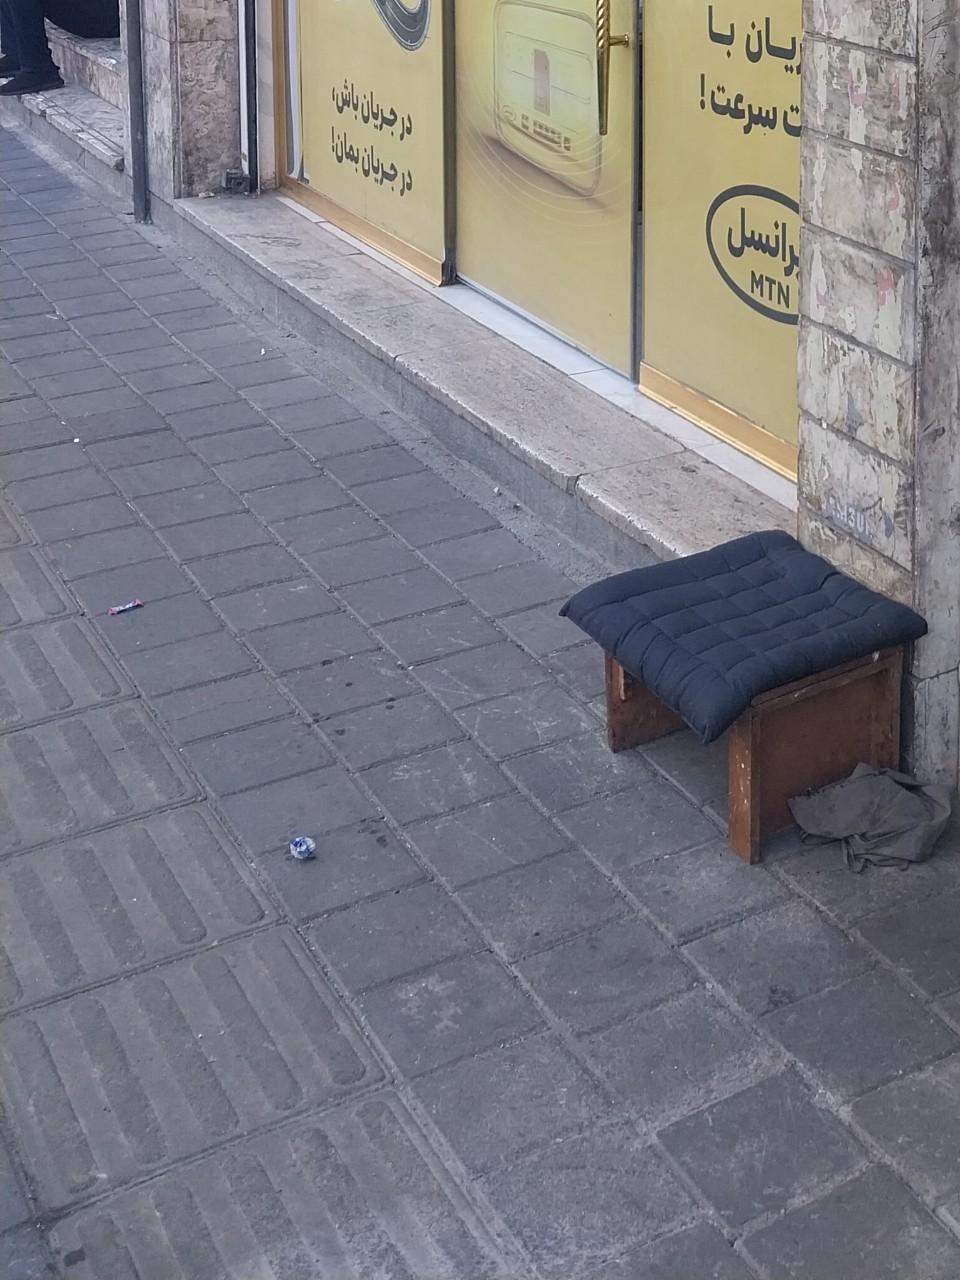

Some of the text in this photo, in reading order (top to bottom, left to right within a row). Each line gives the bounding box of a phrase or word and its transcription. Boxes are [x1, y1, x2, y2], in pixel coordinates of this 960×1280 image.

[708, 5, 735, 59] با
[361, 91, 398, 137] جریان
[399, 114, 413, 141] در
[361, 145, 398, 191] جریان
[399, 169, 413, 197] در
[750, 269, 790, 309] MTN
